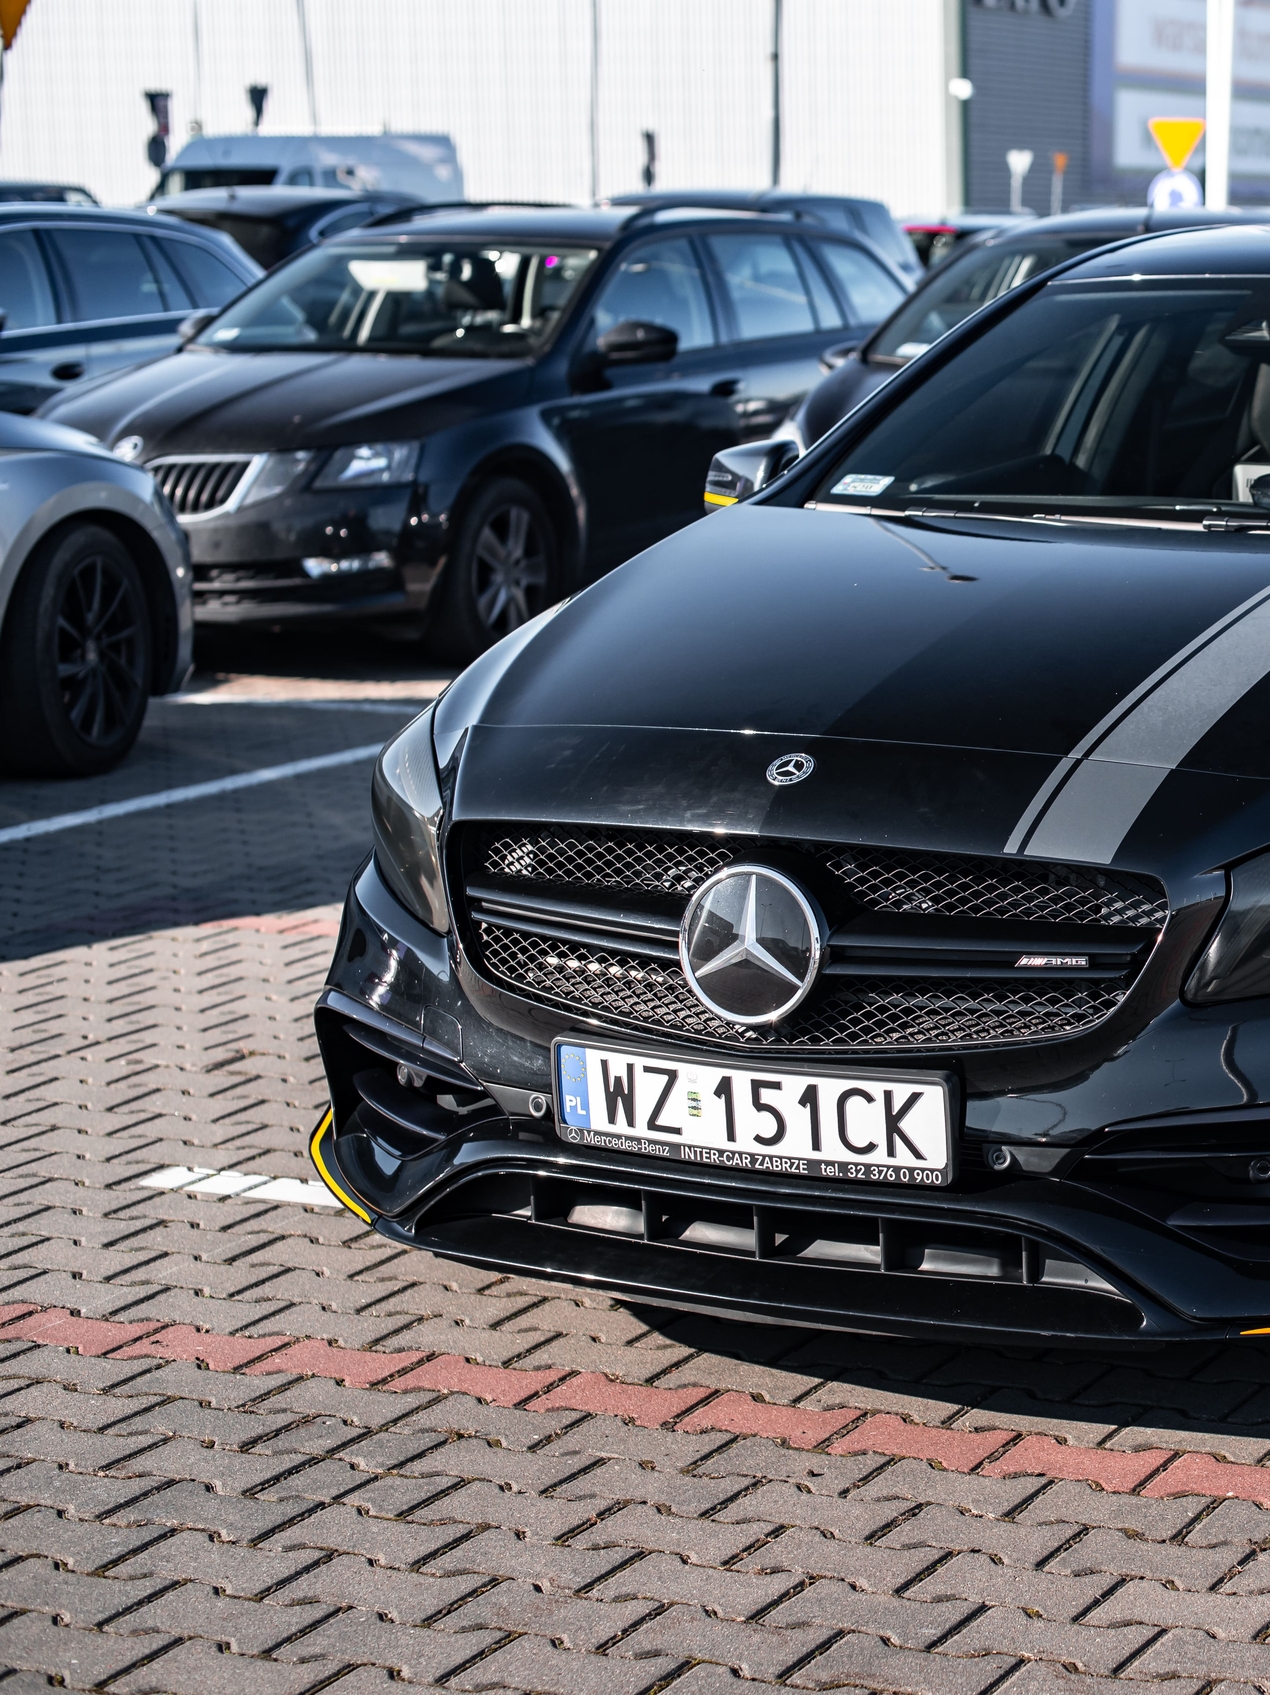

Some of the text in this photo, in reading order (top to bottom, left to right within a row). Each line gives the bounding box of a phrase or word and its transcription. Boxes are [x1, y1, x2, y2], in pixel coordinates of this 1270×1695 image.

[565, 1094, 587, 1115] PL
[600, 1058, 928, 1161] WZ 151CK
[583, 1130, 942, 1184] Mercedes-Benz INTER-CAR ZABRZE tel. 32 376 0 900
